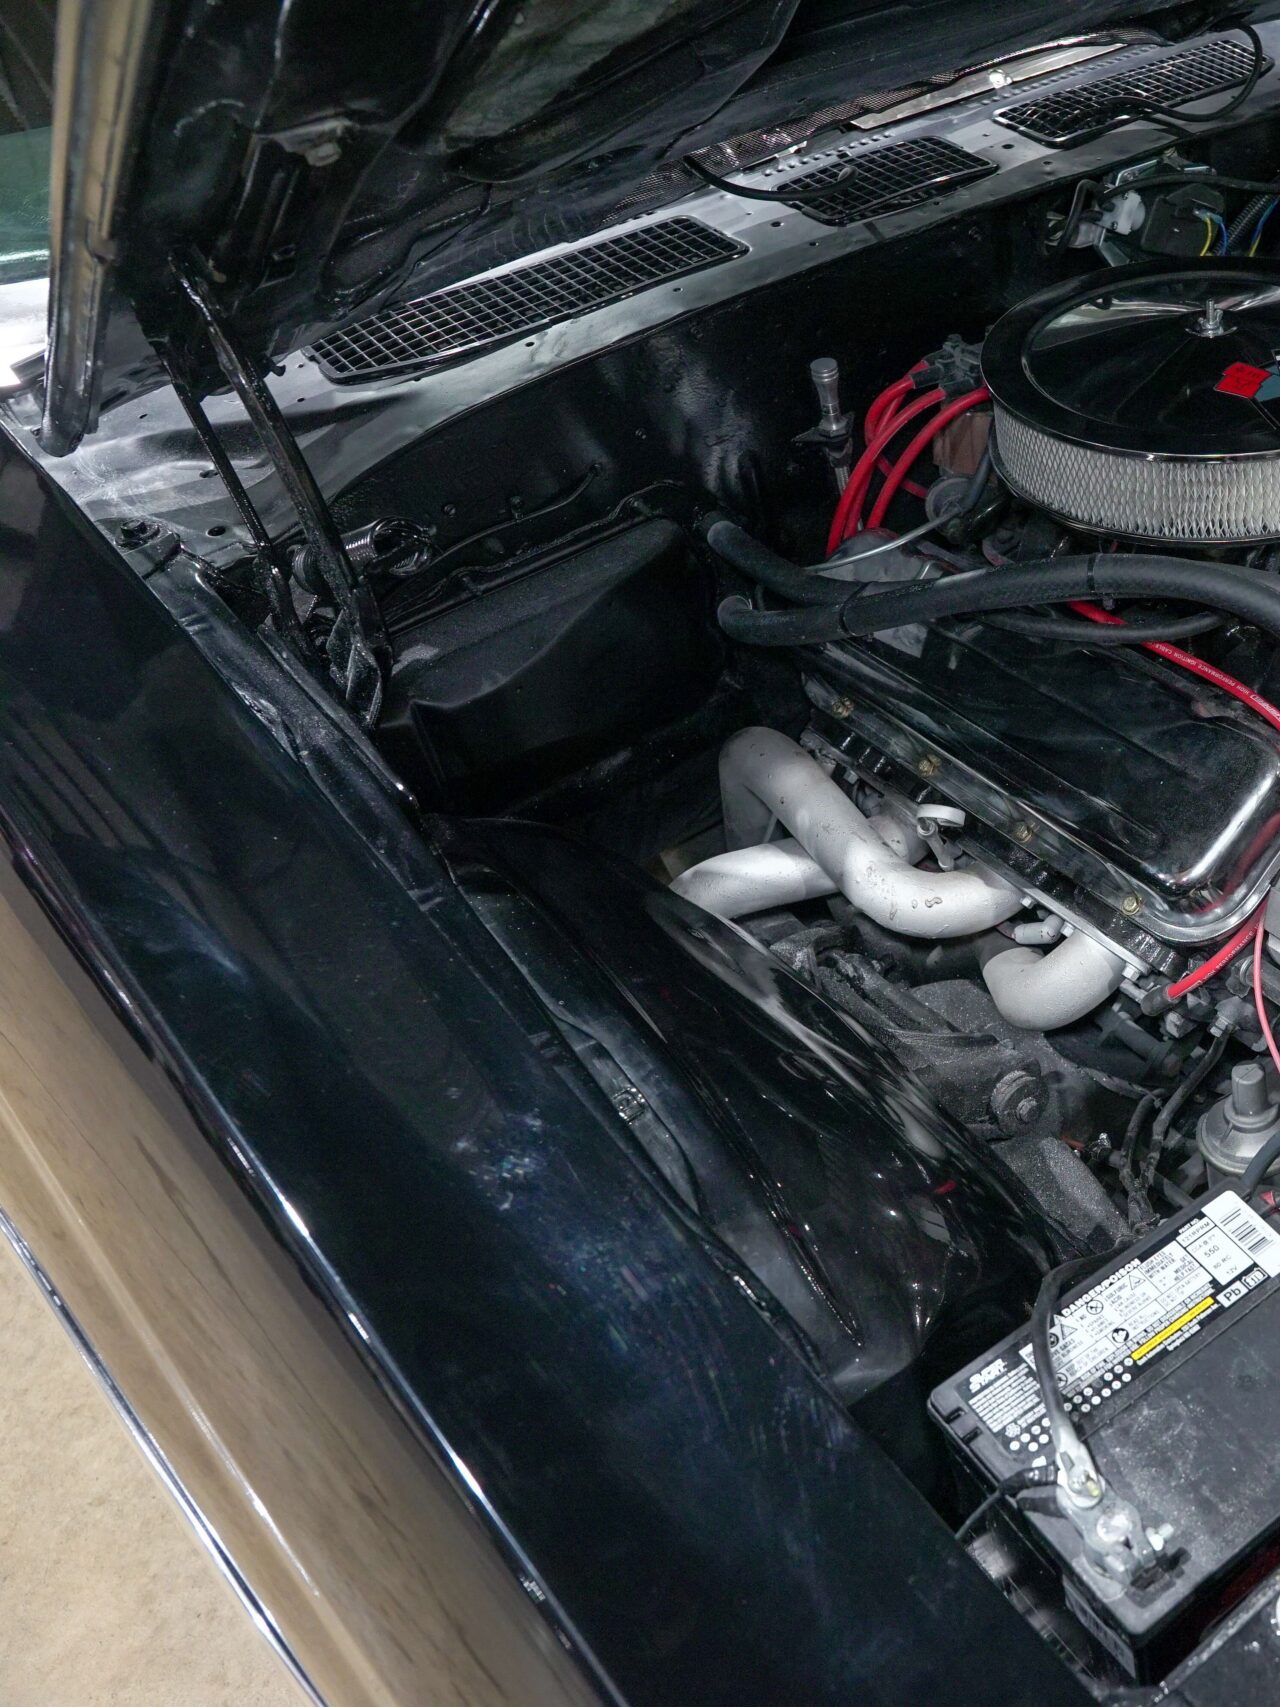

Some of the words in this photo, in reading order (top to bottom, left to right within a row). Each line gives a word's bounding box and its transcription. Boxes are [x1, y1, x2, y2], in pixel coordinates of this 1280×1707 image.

[1204, 1245, 1220, 1257] 550
[1061, 1258, 1141, 1317] DANGER/POISON
[1224, 1286, 1242, 1301] Pb
